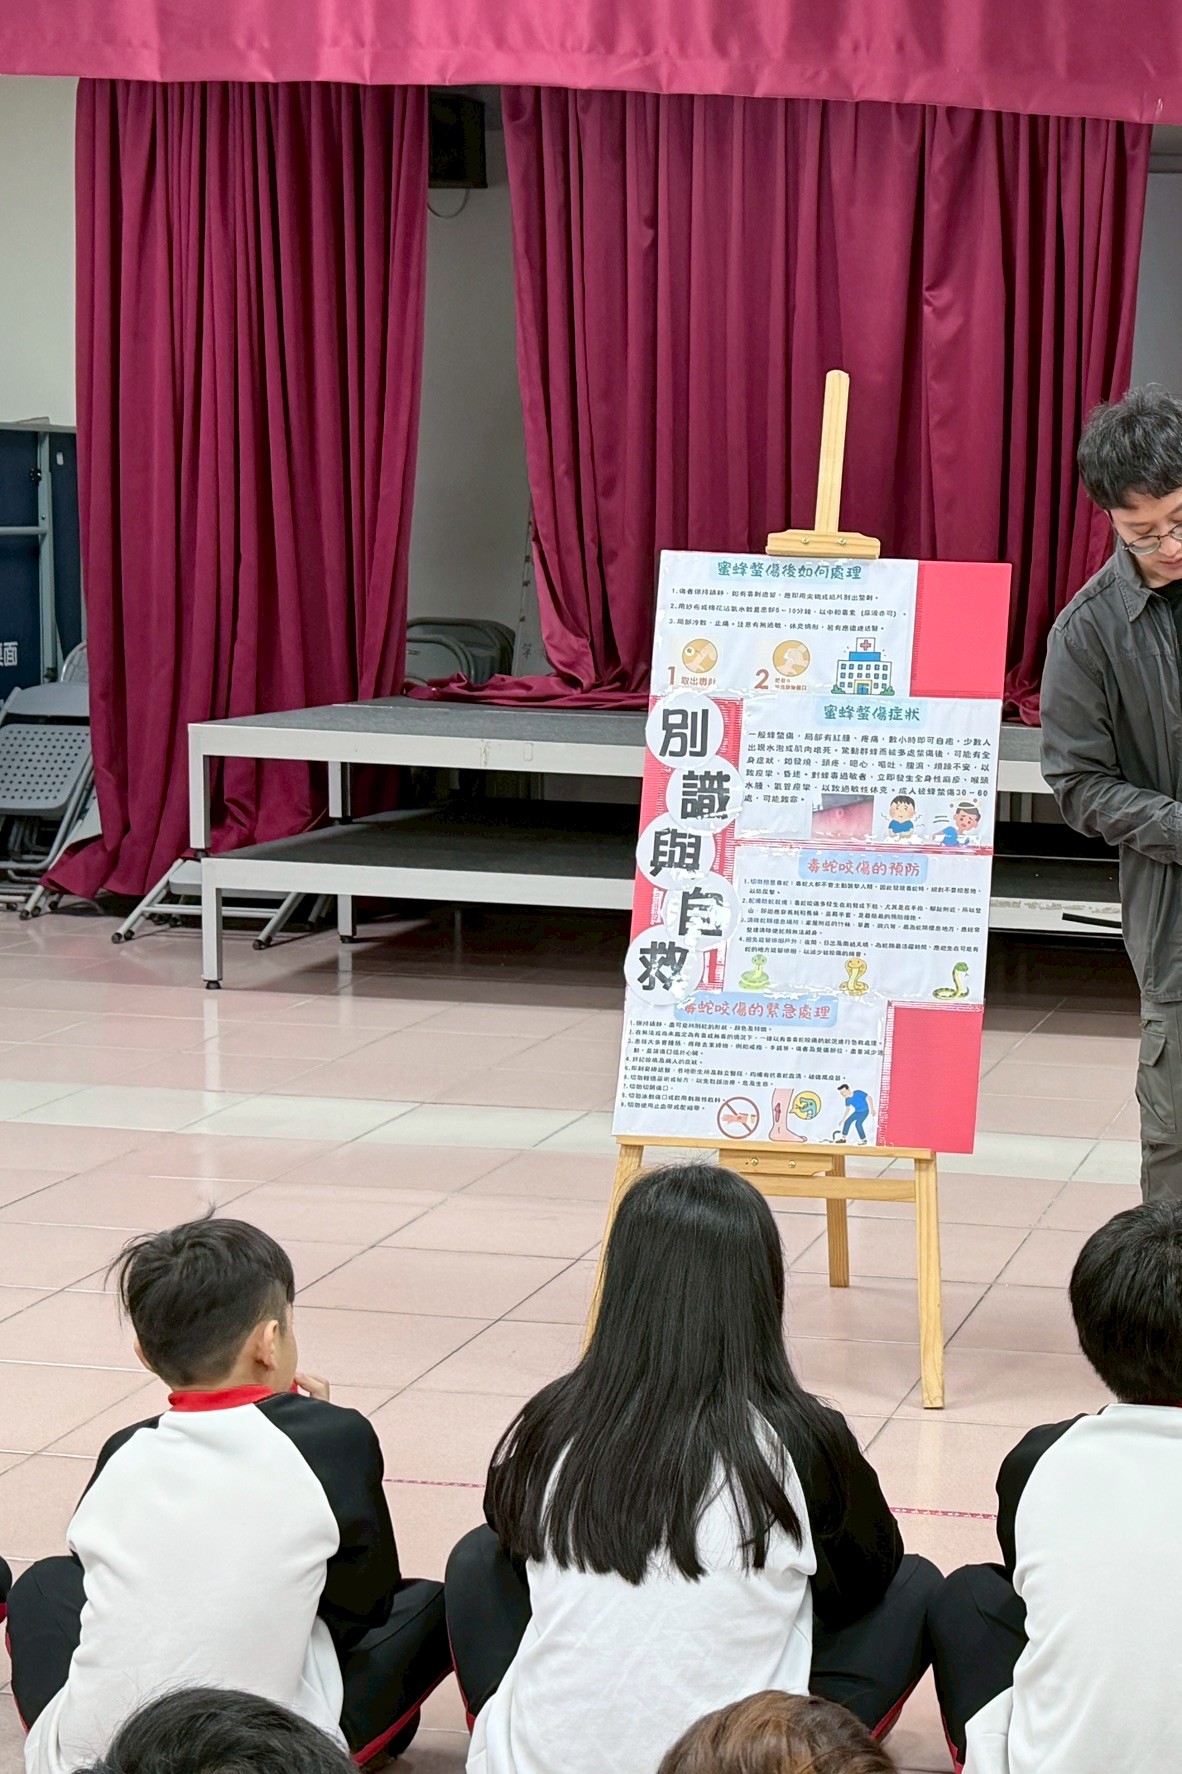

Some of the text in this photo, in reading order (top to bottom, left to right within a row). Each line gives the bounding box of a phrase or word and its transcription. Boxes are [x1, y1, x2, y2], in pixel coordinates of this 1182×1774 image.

[717, 561, 862, 580] 蜜蜂螫傷後如何處理
[0, 641, 19, 667] 面
[667, 666, 676, 686] 1
[754, 668, 770, 690] 2
[824, 704, 921, 721] 蜜蜂螫傷症狀
[807, 858, 920, 877] 毒蛇咬傷的預防
[684, 1000, 831, 1020] 毒蛇咬傷的緊急處理
